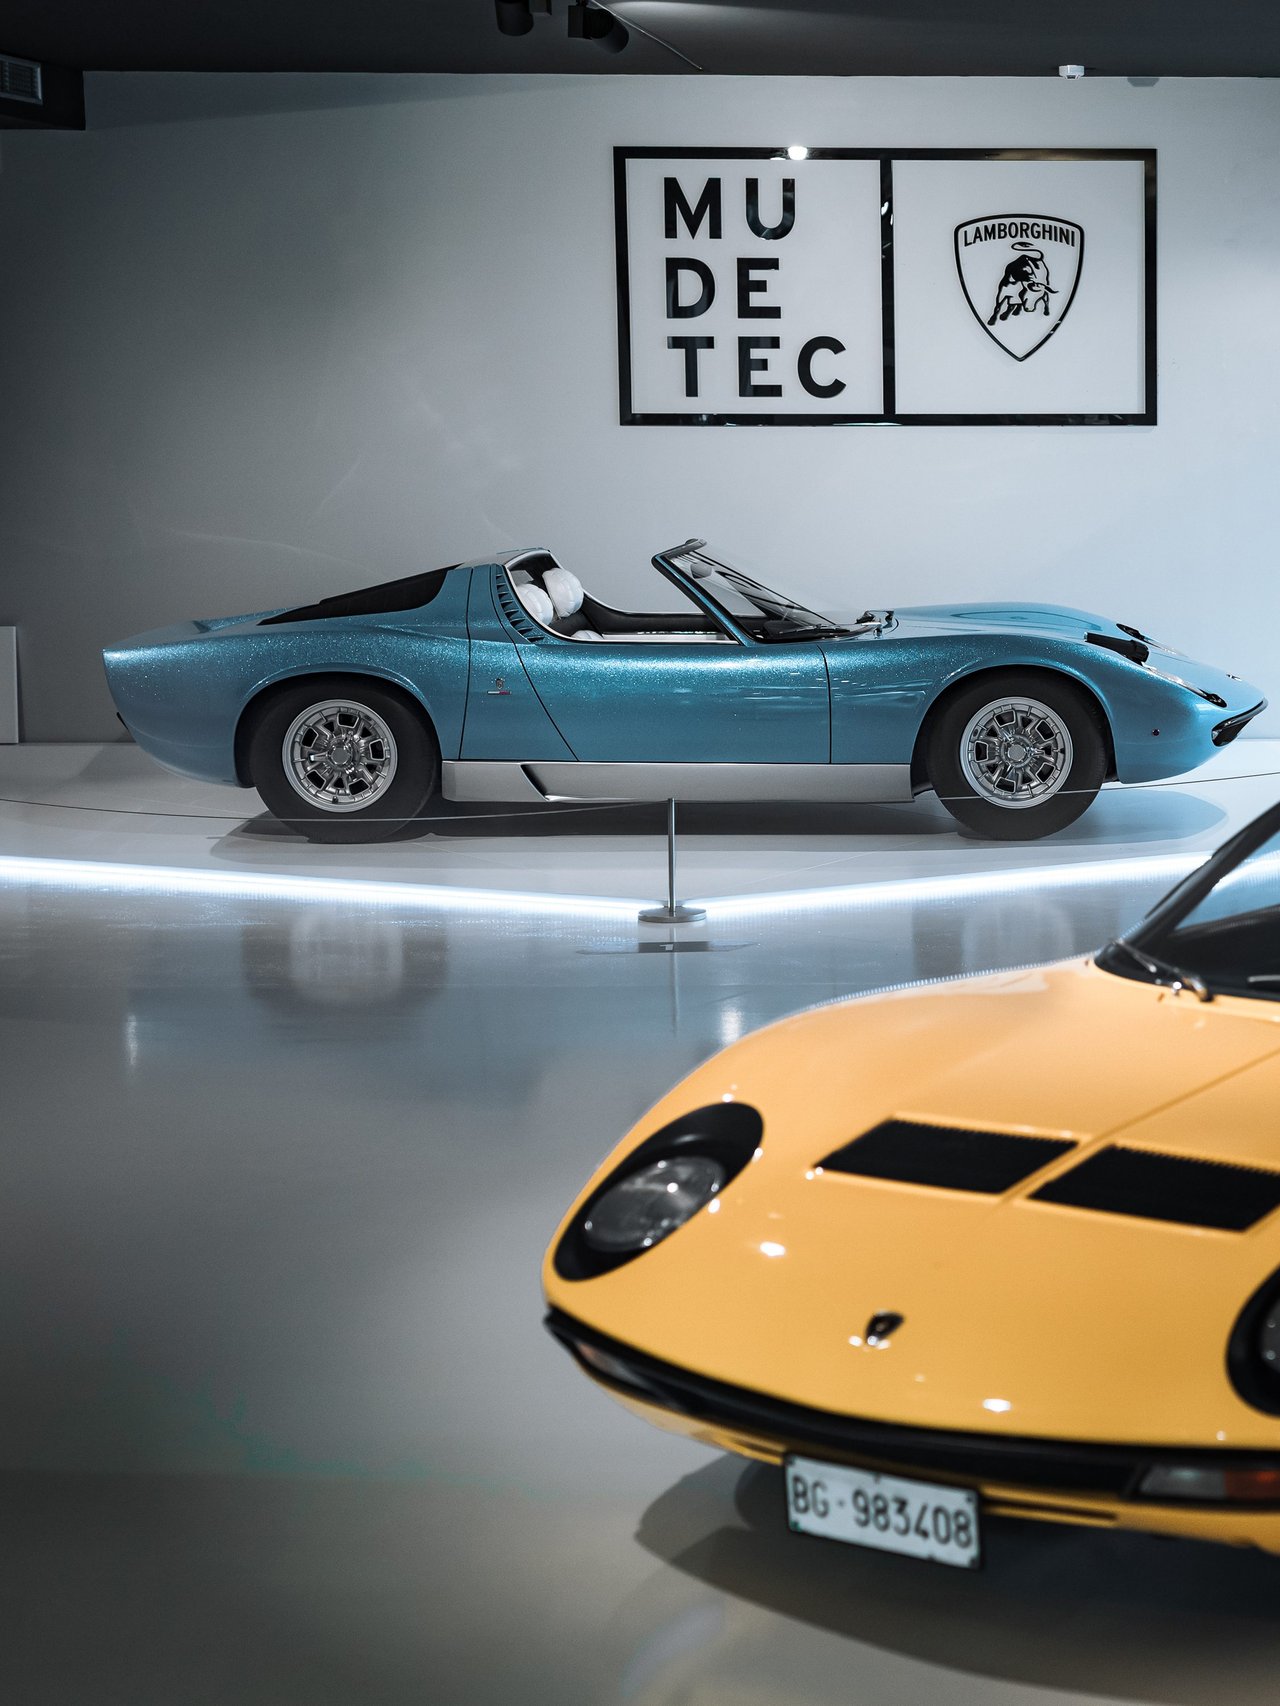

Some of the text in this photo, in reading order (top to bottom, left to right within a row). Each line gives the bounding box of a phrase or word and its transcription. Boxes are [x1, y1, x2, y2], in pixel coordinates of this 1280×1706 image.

[664, 177, 796, 240] MU
[963, 221, 1076, 248] LAMBORGHINI
[666, 257, 782, 319] DE
[667, 335, 847, 399] TEC
